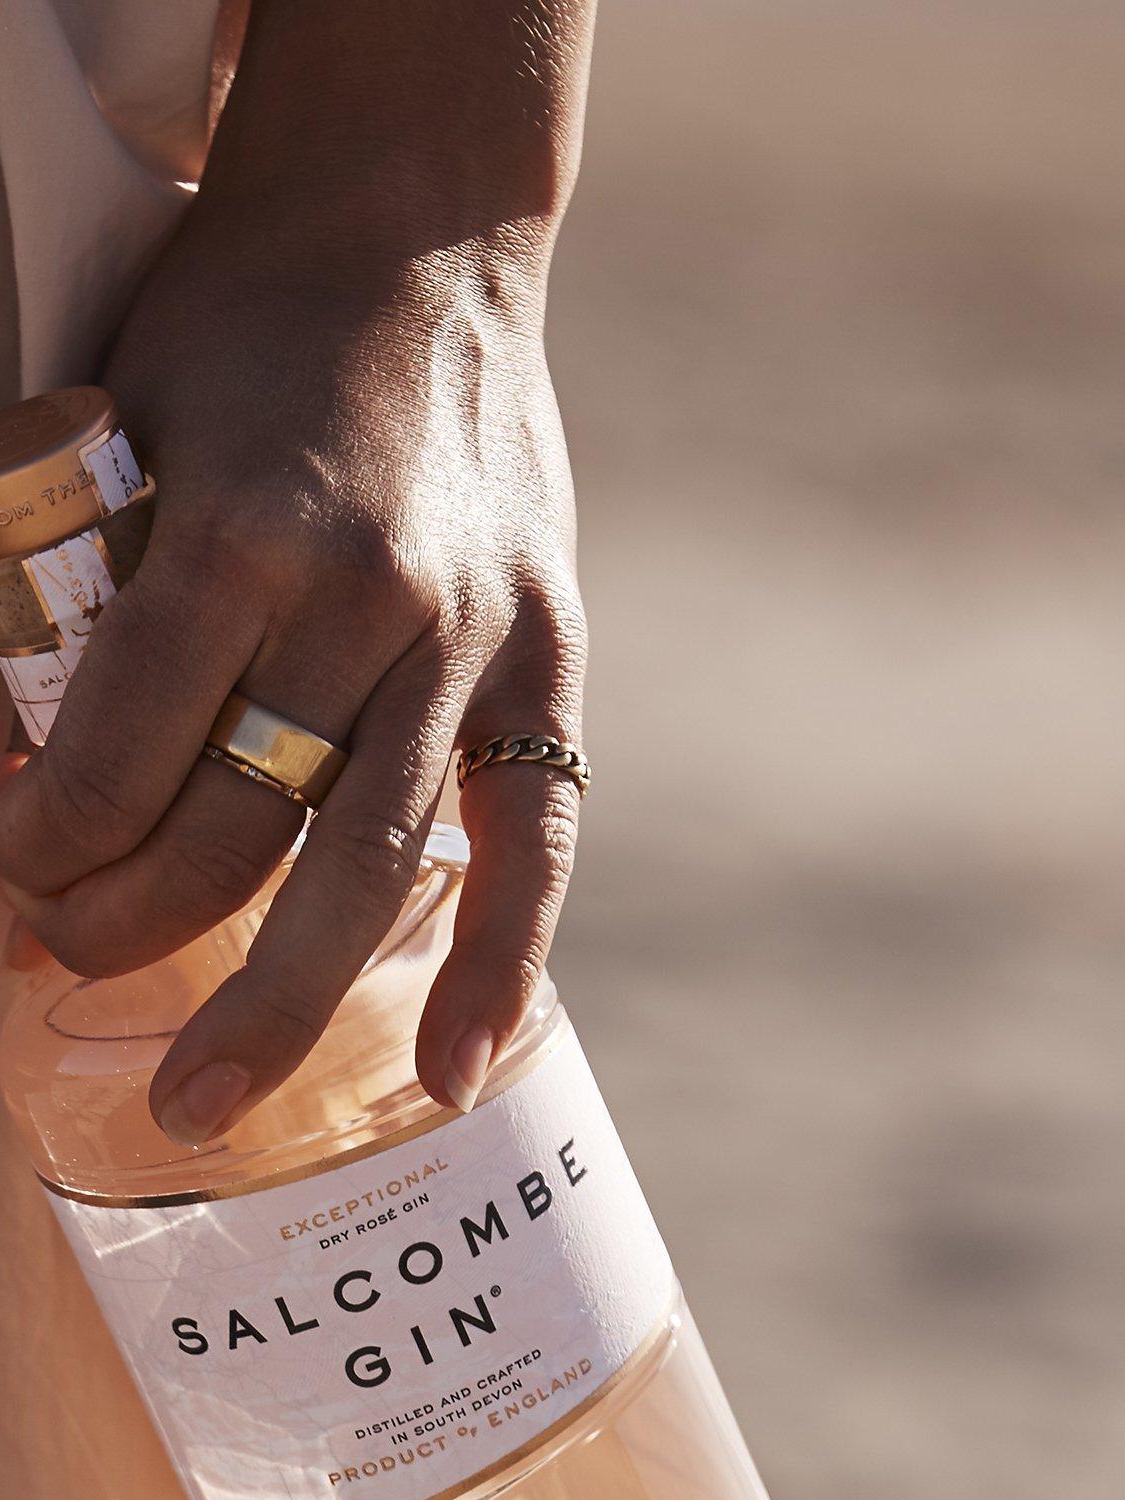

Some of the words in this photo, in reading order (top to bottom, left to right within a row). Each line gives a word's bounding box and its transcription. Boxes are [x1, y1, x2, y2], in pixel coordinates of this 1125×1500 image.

[41, 470, 90, 507] THE
[279, 1158, 449, 1241] EXCEPTIONAL
[319, 1230, 351, 1250] DRY
[356, 1208, 398, 1235] ROSÉ
[402, 1193, 430, 1214] GIN
[172, 1138, 588, 1355] SALCOMBE
[328, 1436, 447, 1486] PRODUCT
[487, 1357, 593, 1428] ENGLAND
[355, 1404, 434, 1440] DISTILLED
[441, 1388, 471, 1407] AND
[477, 1349, 542, 1390] CRAFTED
[391, 1425, 407, 1445] IN
[414, 1409, 467, 1436] SOUTH
[472, 1379, 523, 1412] DEVON
